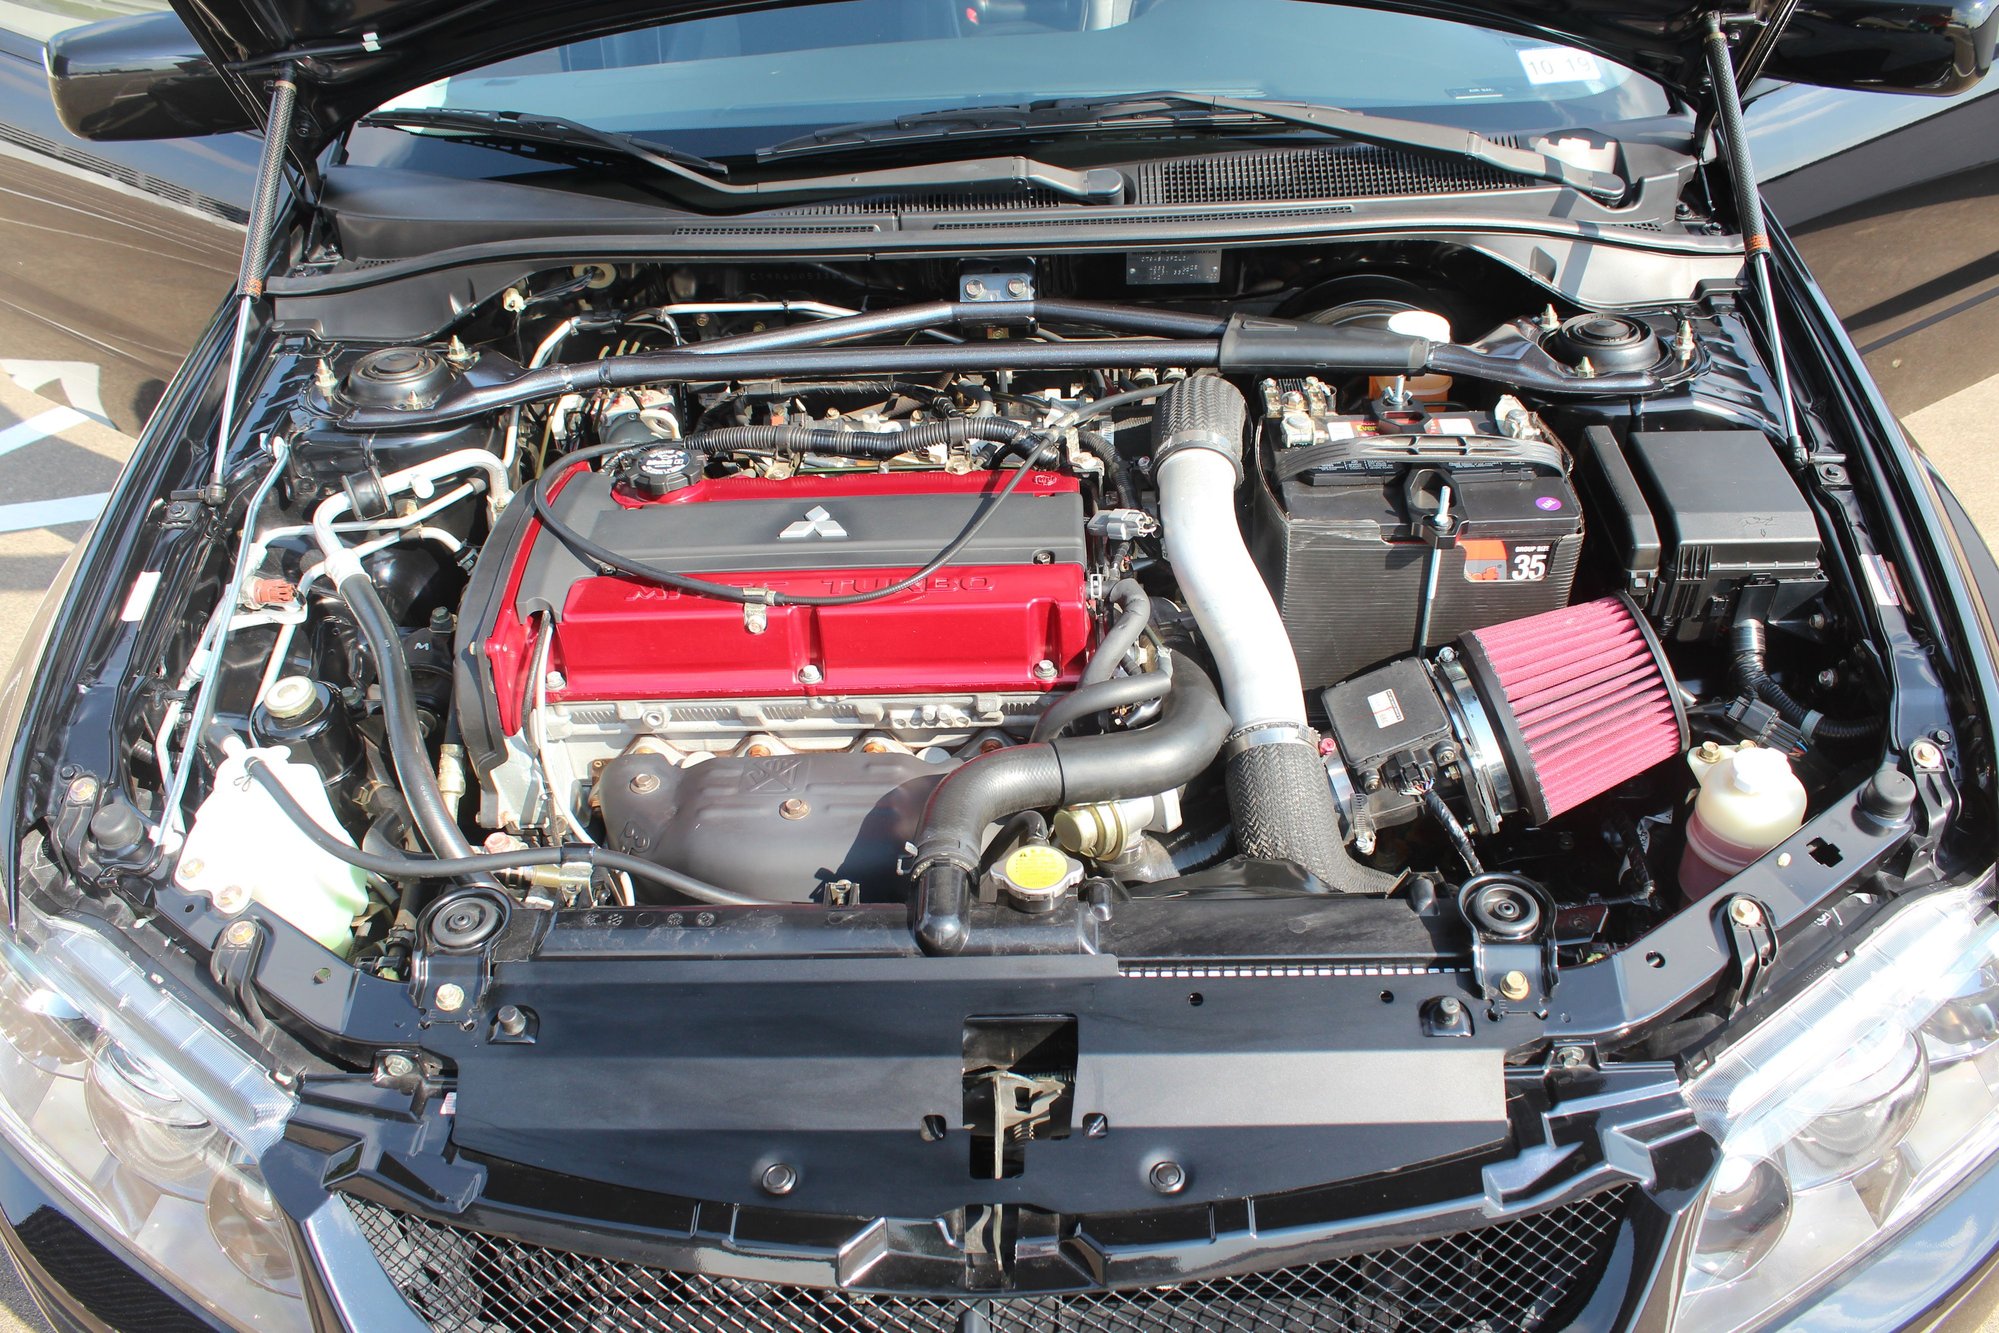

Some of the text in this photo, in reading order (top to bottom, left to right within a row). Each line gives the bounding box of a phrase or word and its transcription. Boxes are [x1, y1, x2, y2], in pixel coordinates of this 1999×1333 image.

[1527, 55, 1591, 76] 10 19
[1511, 554, 1547, 581] 35
